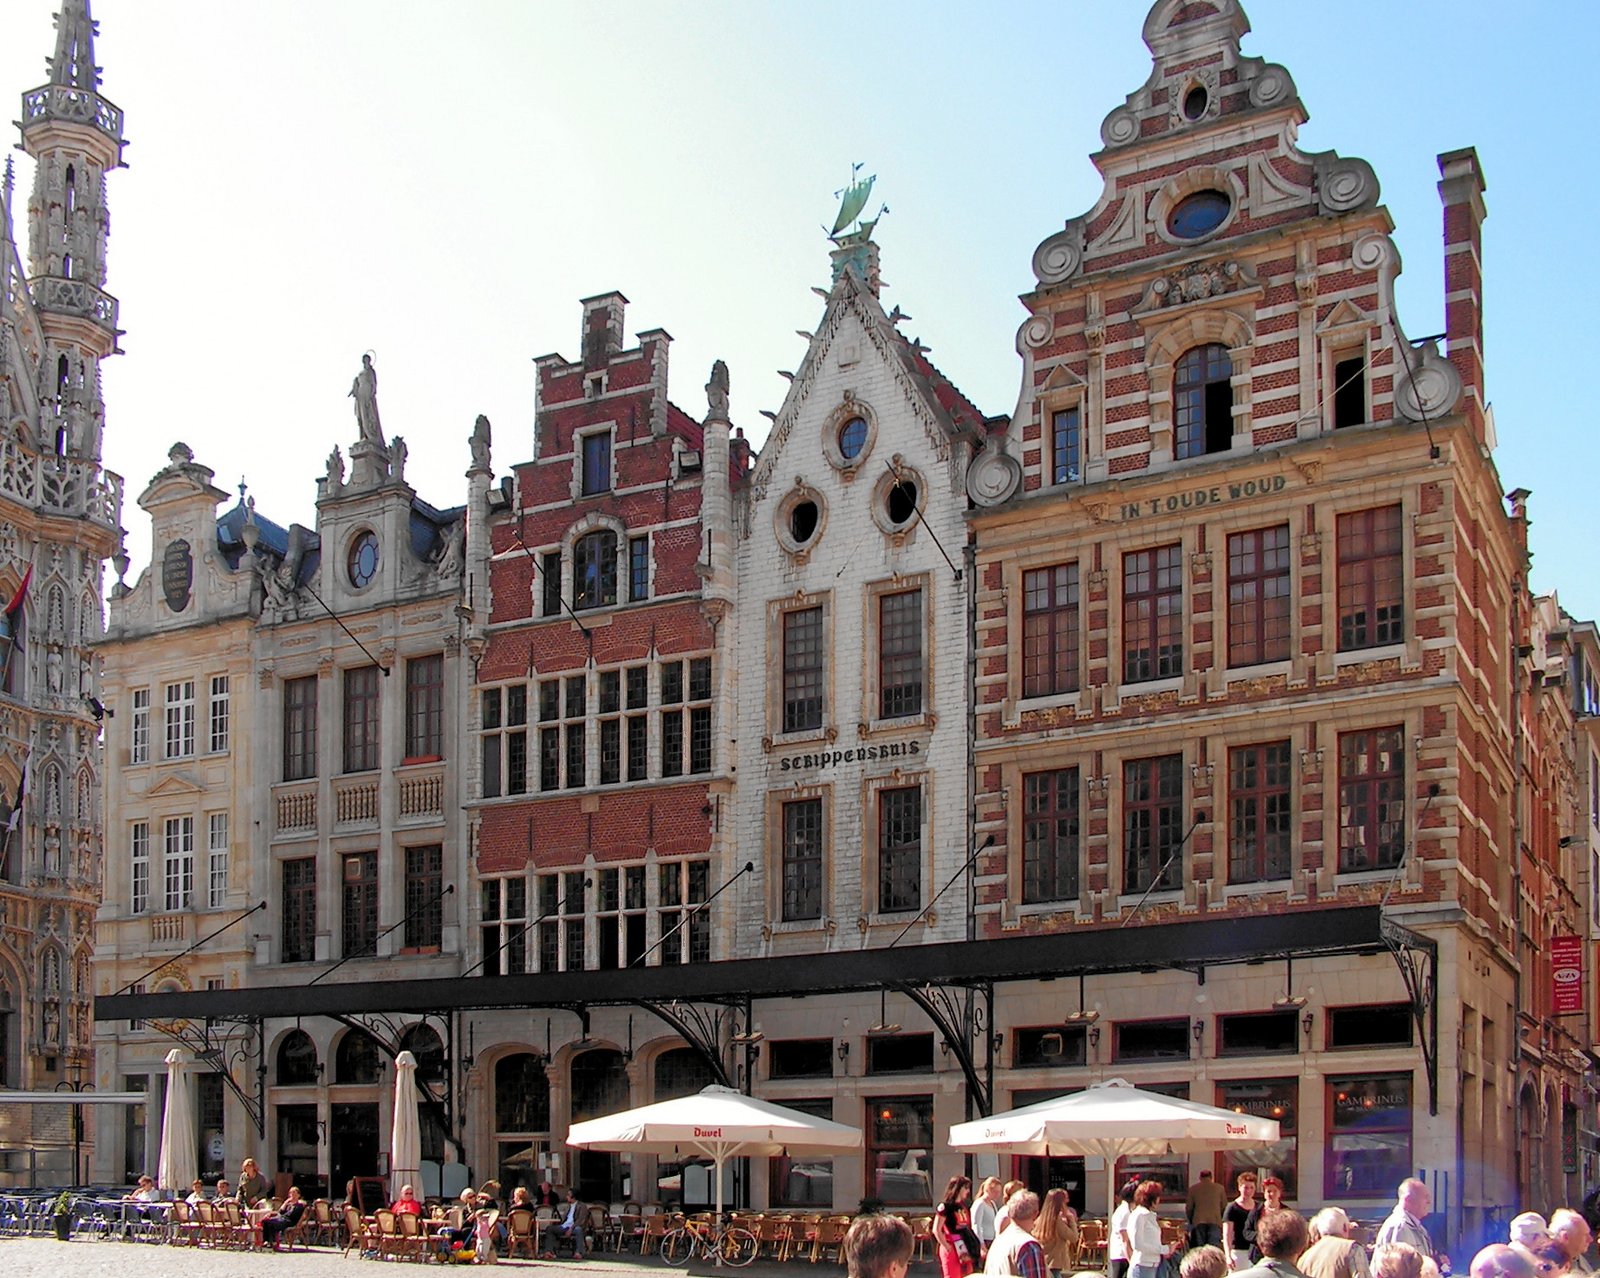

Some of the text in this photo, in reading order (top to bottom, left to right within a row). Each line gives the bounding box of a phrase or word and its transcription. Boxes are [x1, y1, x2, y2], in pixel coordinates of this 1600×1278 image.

[1119, 503, 1140, 520] IN
[1166, 487, 1222, 511] OUDE
[1228, 475, 1286, 499] WOUD
[693, 1126, 723, 1138] Duvel
[984, 1127, 1007, 1138] Duvel
[1225, 1122, 1249, 1135] Duvel
